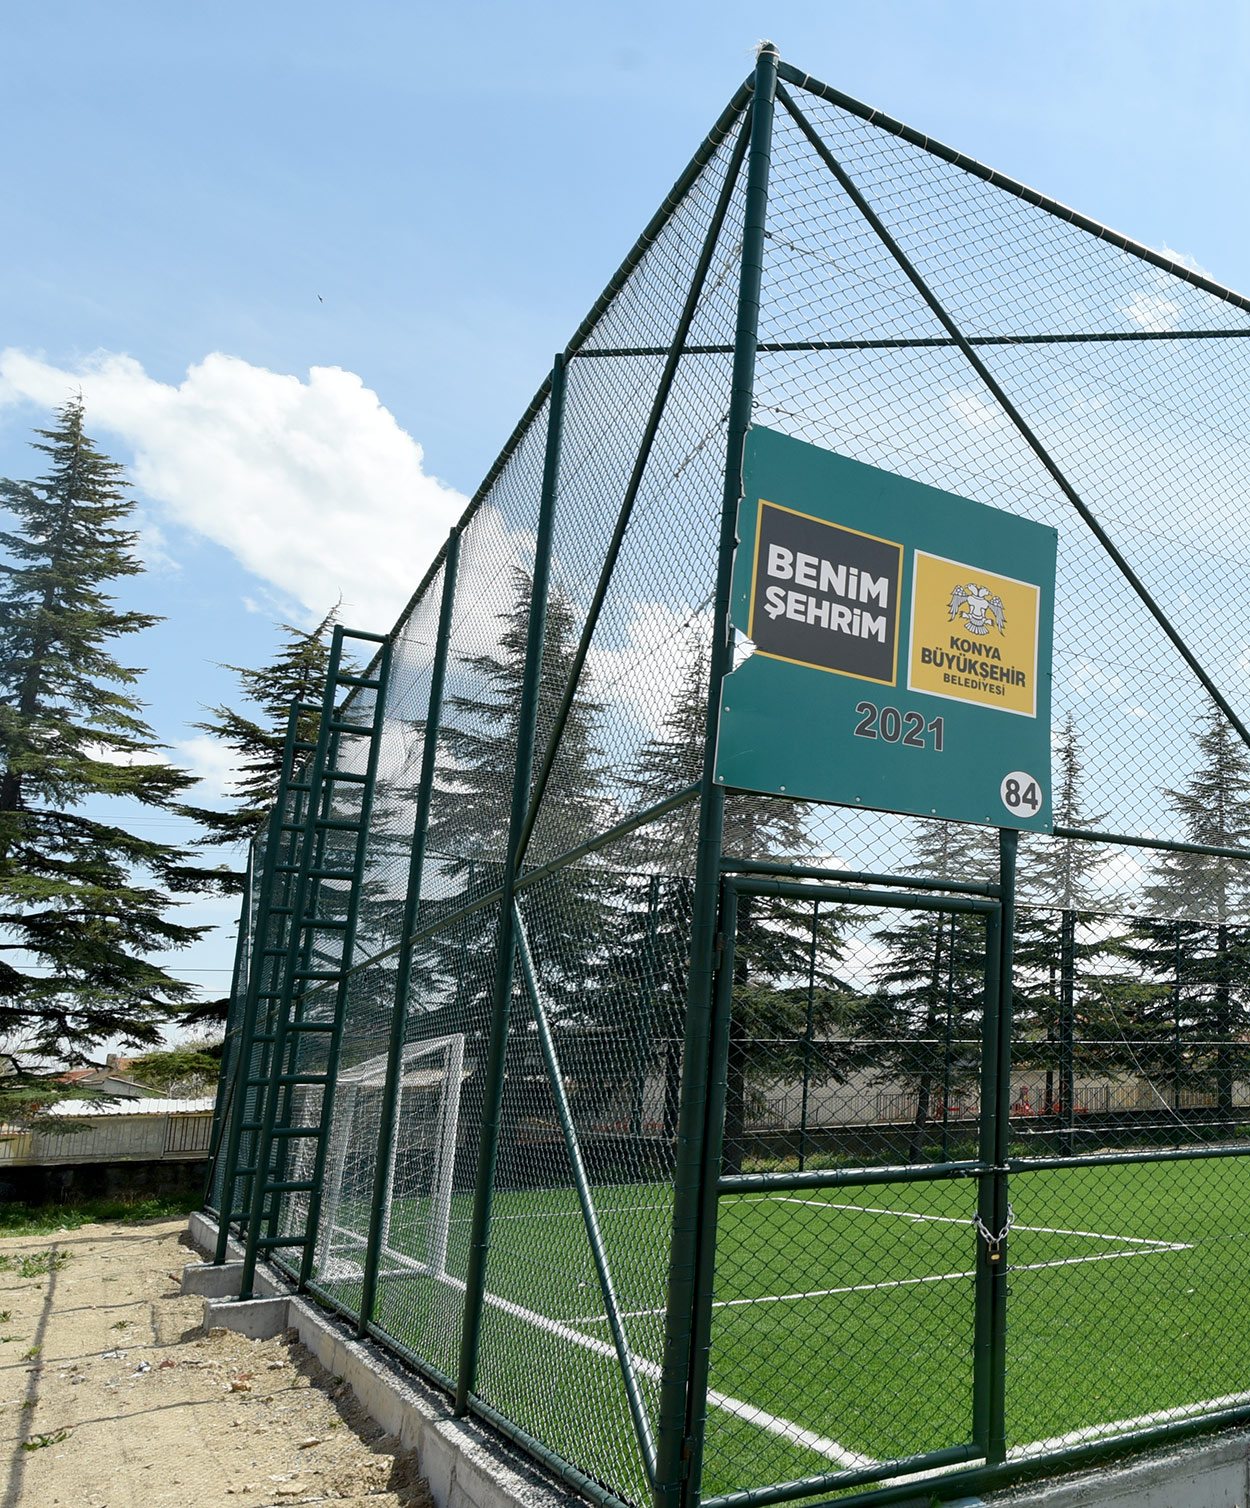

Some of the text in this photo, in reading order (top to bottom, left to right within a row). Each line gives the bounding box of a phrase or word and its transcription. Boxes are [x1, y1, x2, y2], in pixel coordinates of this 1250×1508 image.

[950, 635, 1001, 661] KONYA
[921, 646, 1026, 688] BÜYÜKŞEHİR
[943, 673, 1005, 696] BELEDİYESİ
[854, 701, 944, 752] 2021
[1004, 778, 1039, 810] 84
